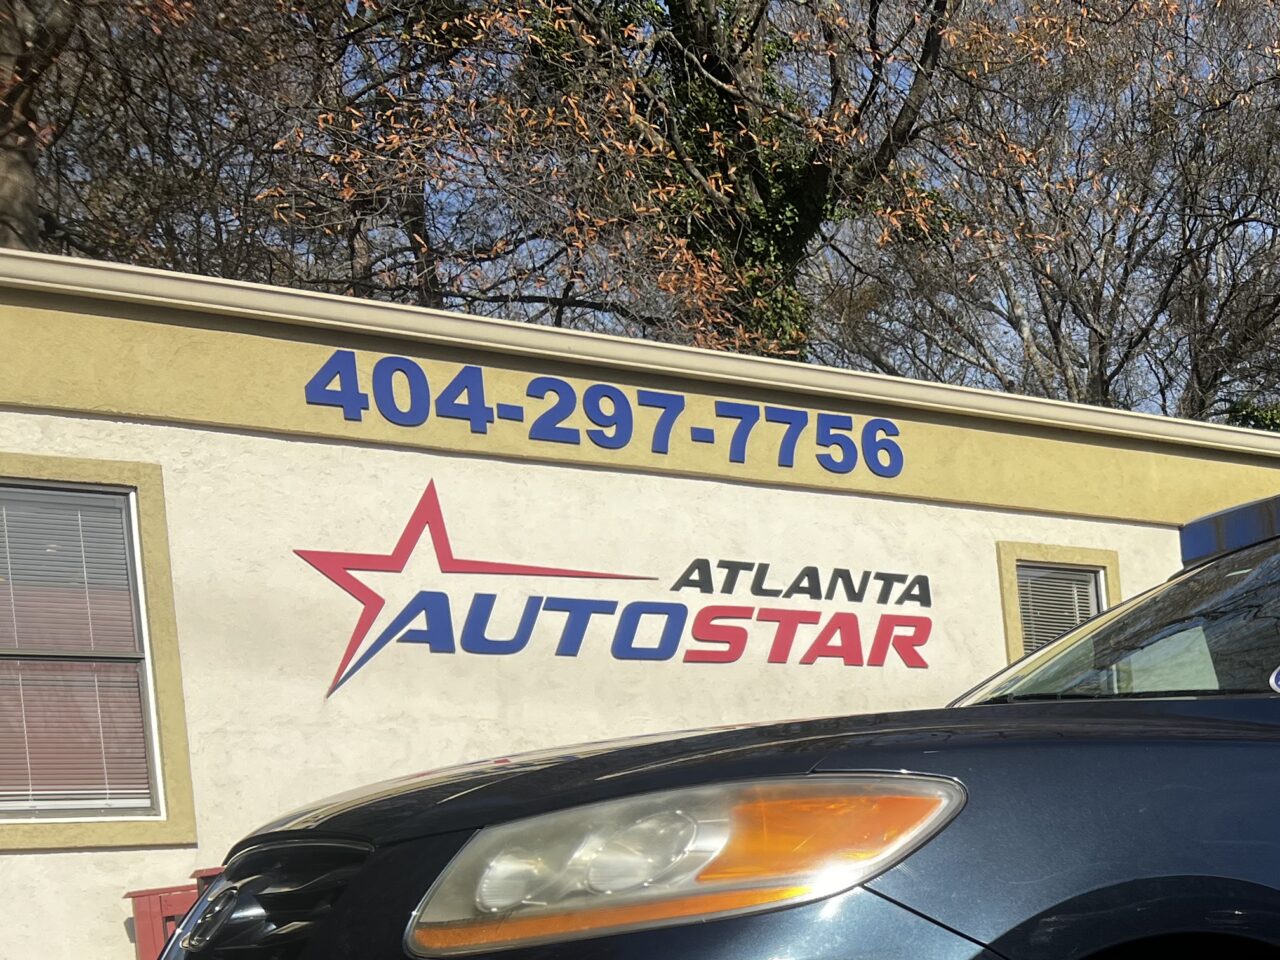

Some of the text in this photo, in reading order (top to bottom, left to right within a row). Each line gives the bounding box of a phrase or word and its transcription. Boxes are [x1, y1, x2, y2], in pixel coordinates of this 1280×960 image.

[304, 350, 904, 478] 404-297-7756
[670, 558, 932, 608] ATLANTA
[395, 590, 933, 668] AUTOSTAR
